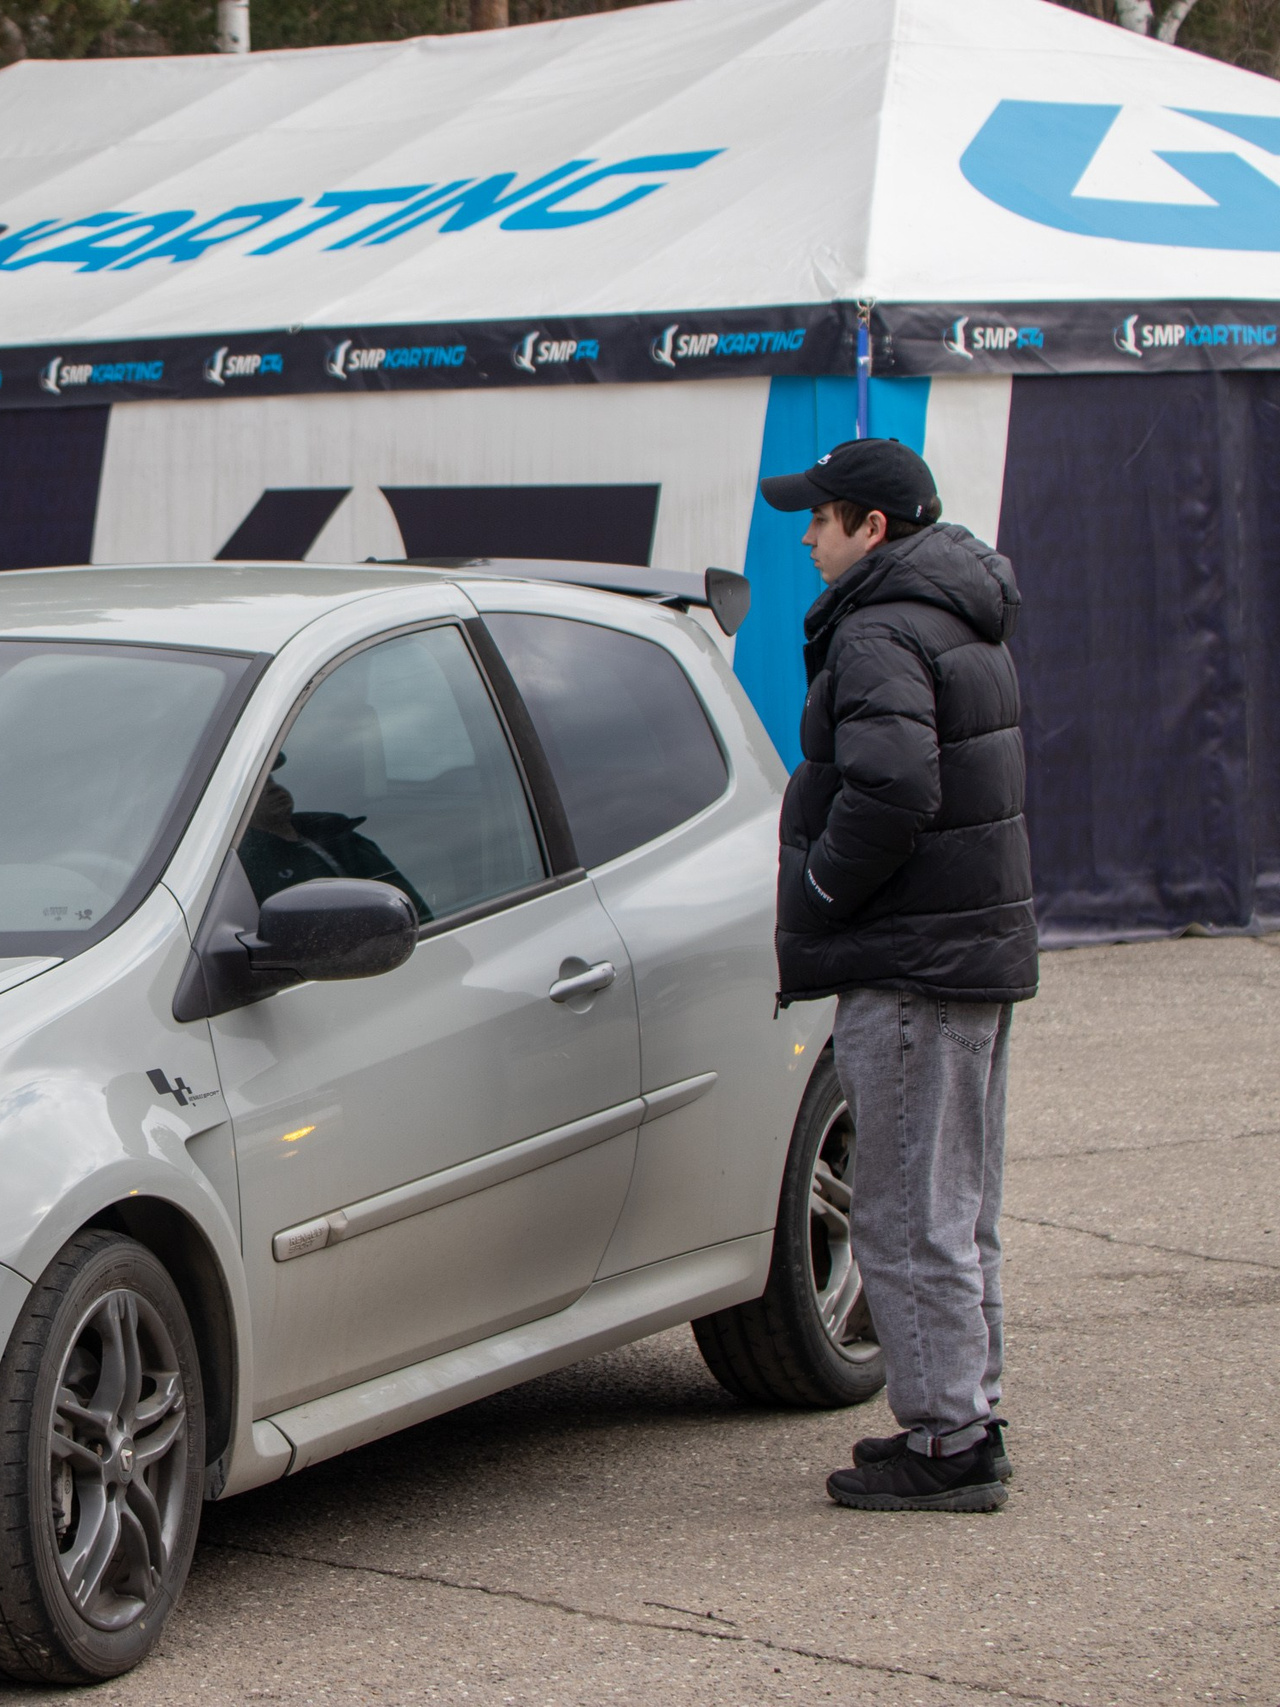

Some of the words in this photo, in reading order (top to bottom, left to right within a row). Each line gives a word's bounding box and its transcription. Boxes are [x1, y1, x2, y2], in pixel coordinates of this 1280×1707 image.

[677, 328, 807, 357] SMPKARTING
[1141, 322, 1278, 348] SMPKARTING
[348, 345, 467, 371] SMPKARTING
[59, 360, 164, 386] SMPKARTING
